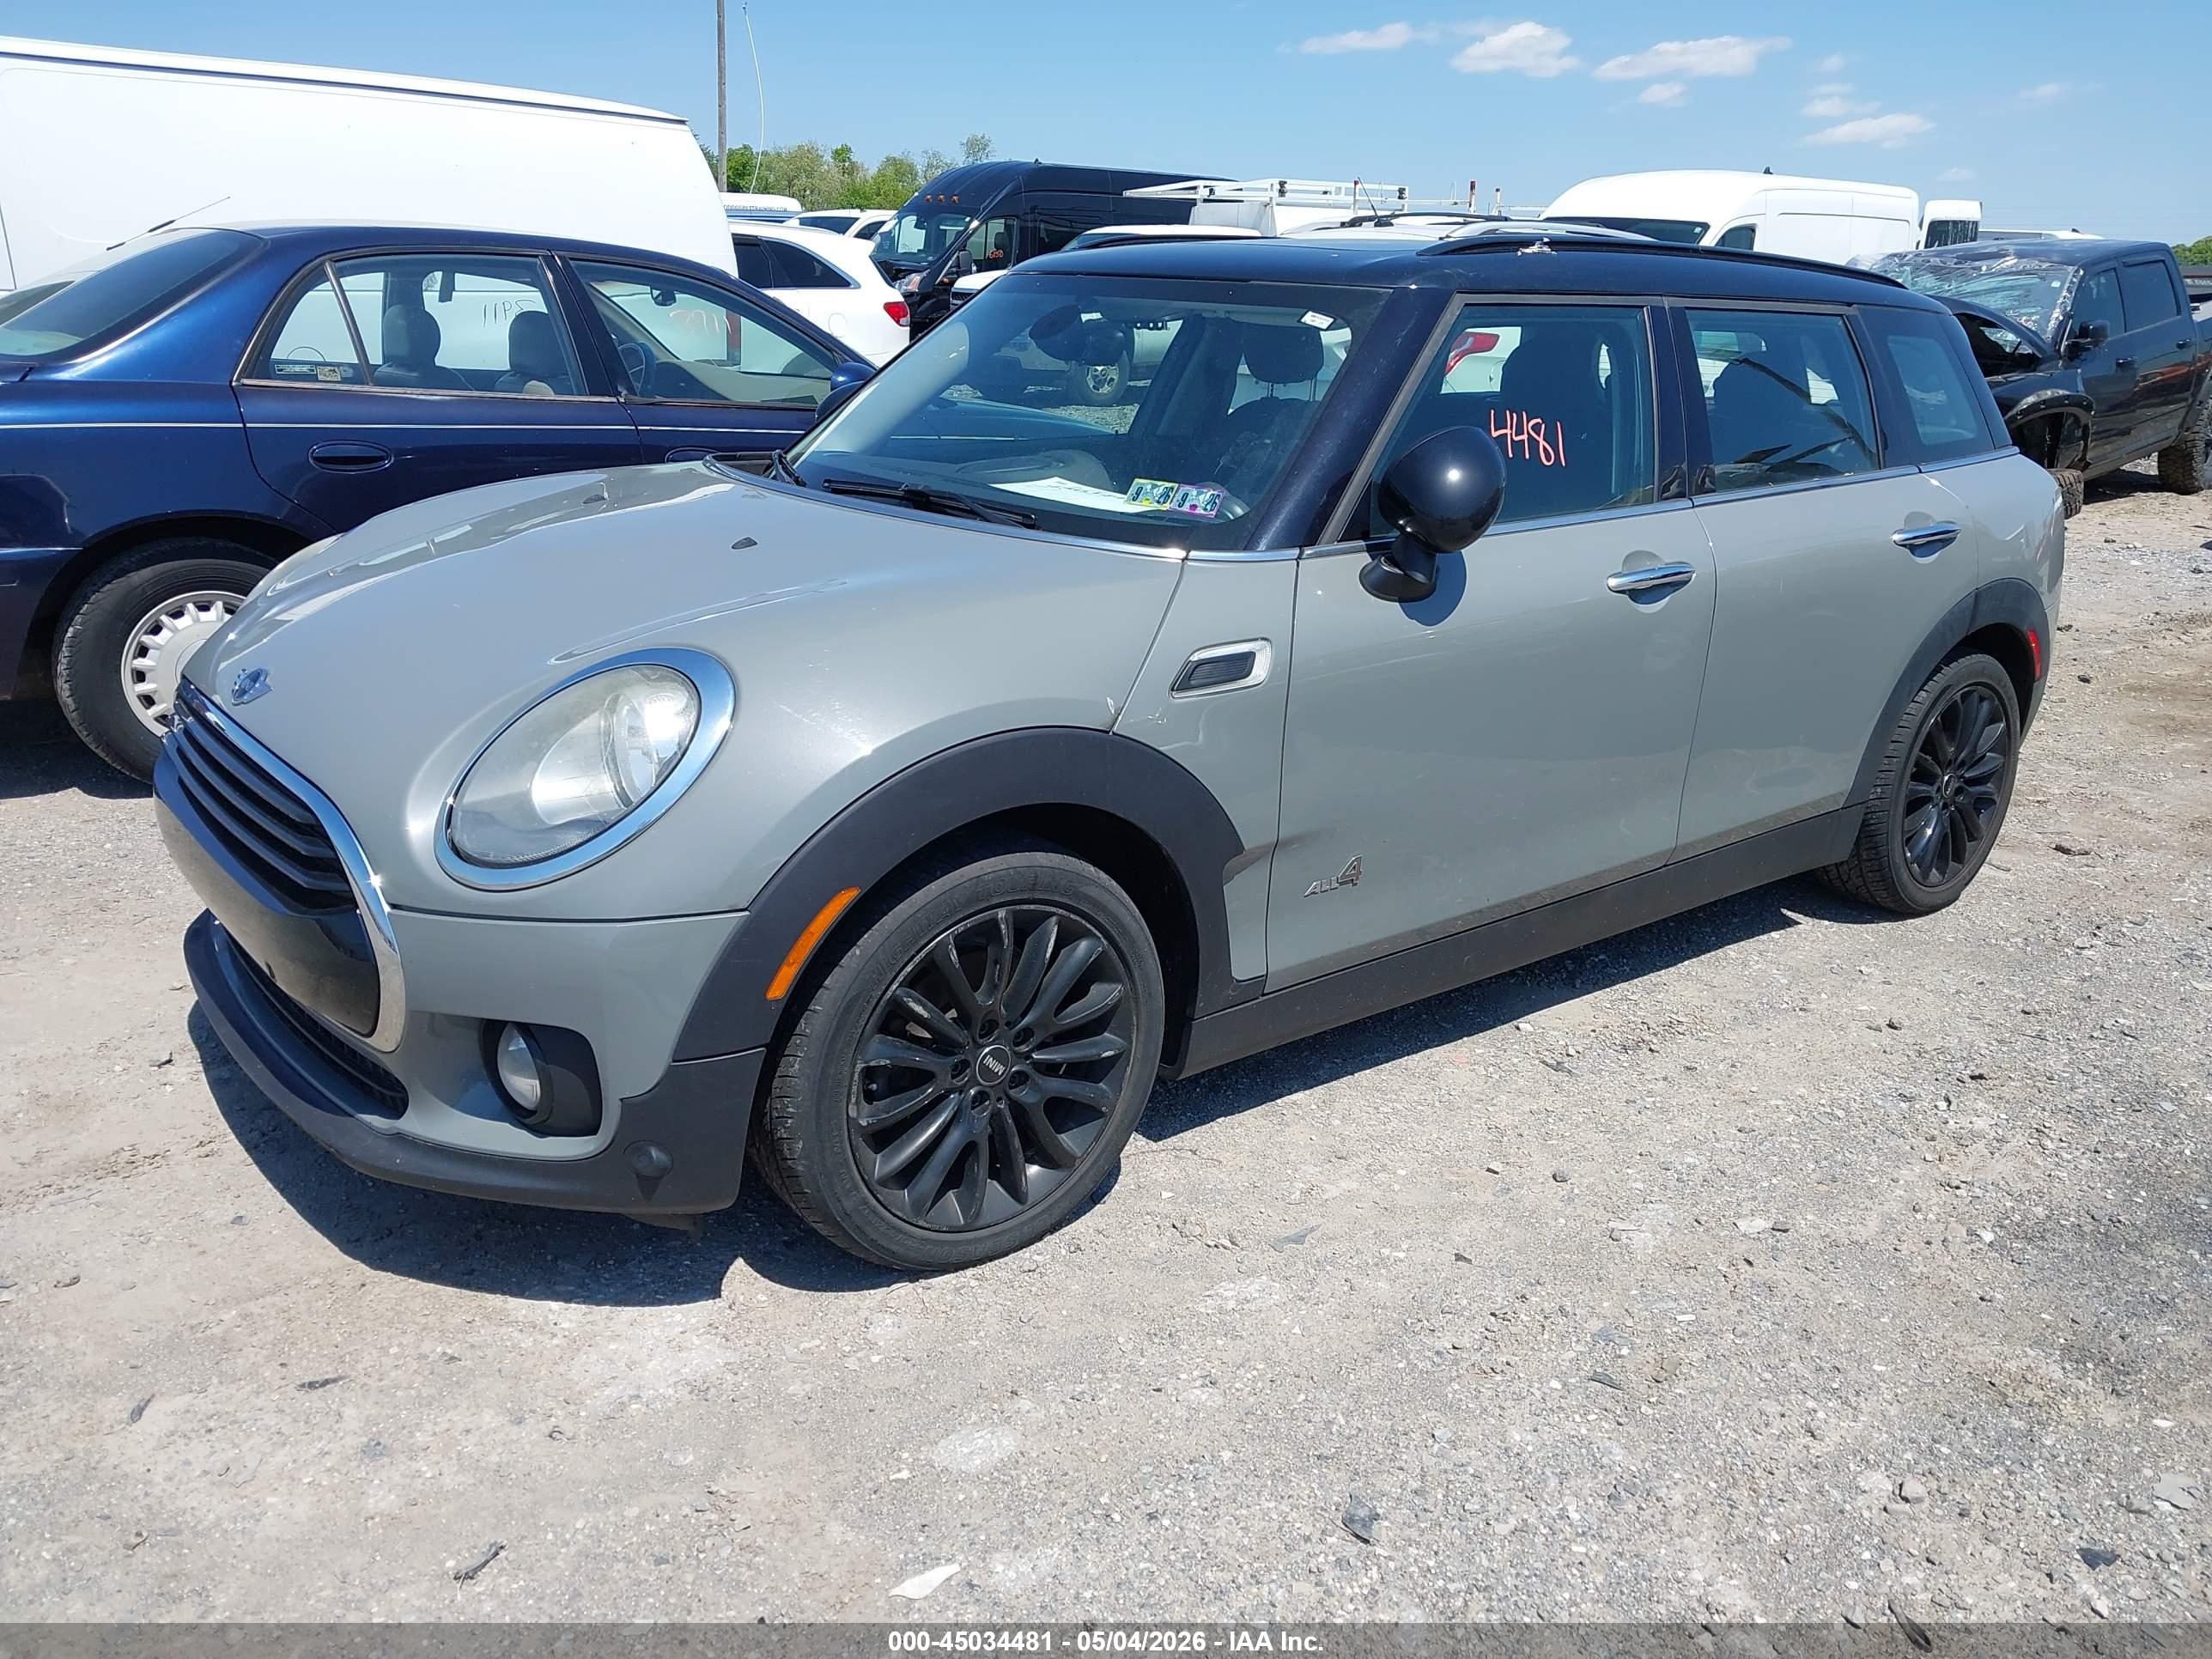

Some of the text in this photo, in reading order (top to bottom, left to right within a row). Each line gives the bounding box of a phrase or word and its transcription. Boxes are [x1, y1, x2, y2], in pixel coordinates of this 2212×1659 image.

[1490, 409, 1566, 467] 4481
[1132, 486, 1143, 501] 9
[1156, 487, 1174, 504] 26
[1177, 492, 1221, 511] 9 26
[982, 1054, 1006, 1076] MINI
